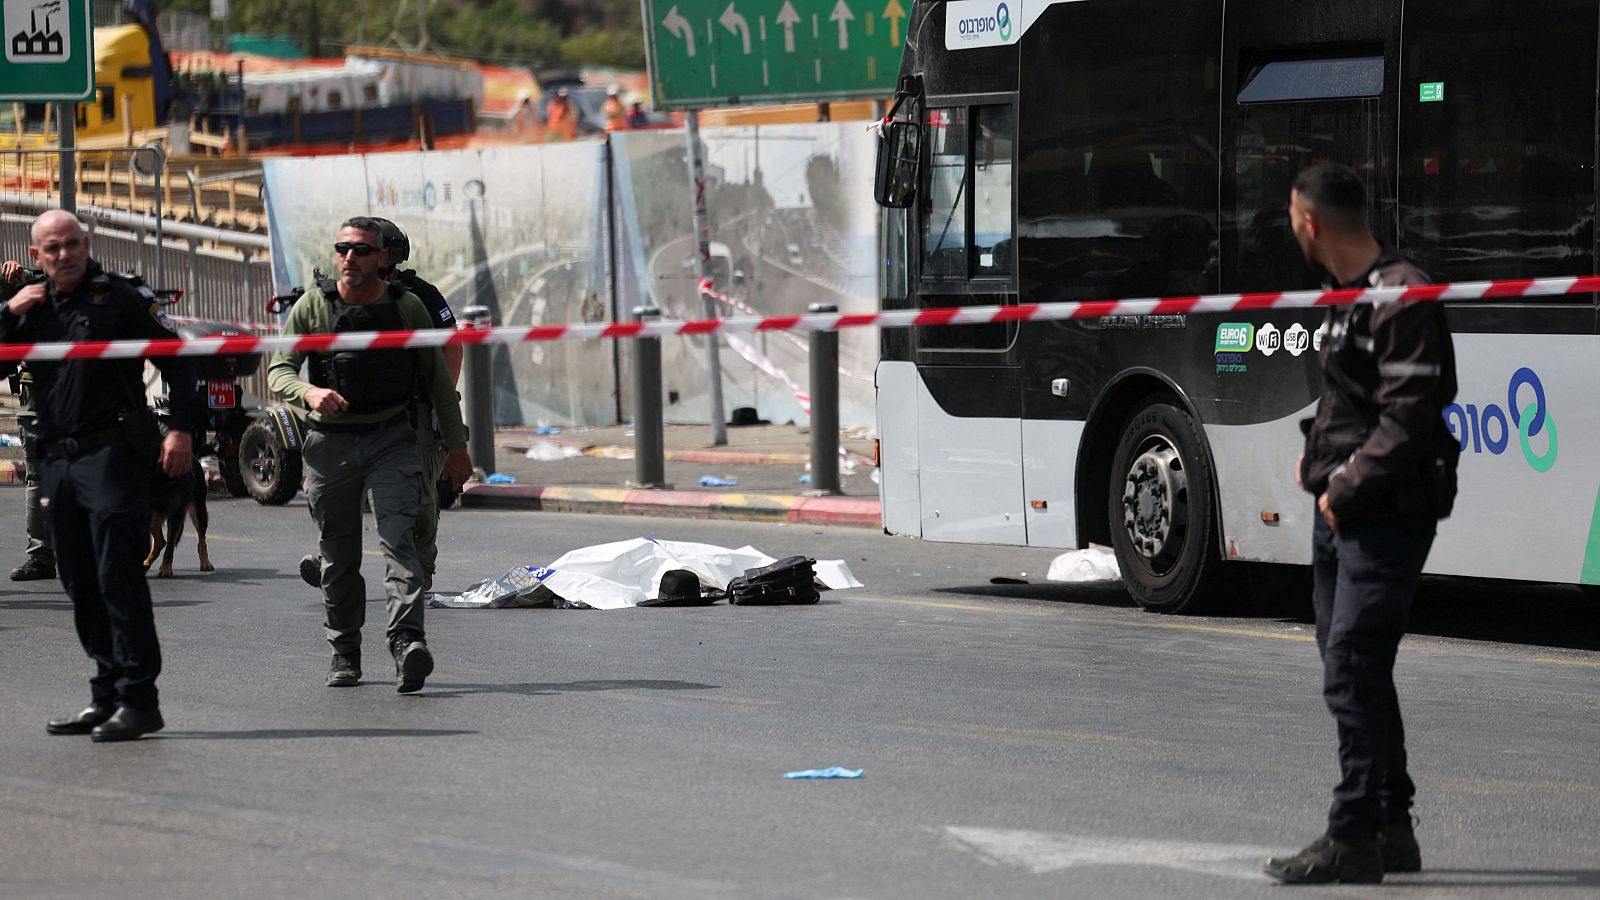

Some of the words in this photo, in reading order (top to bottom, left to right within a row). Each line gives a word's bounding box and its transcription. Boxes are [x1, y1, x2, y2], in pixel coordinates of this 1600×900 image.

[959, 17, 995, 34] סופרבוס
[1143, 315, 1187, 329] DRAGON
[1286, 332, 1296, 342] USB
